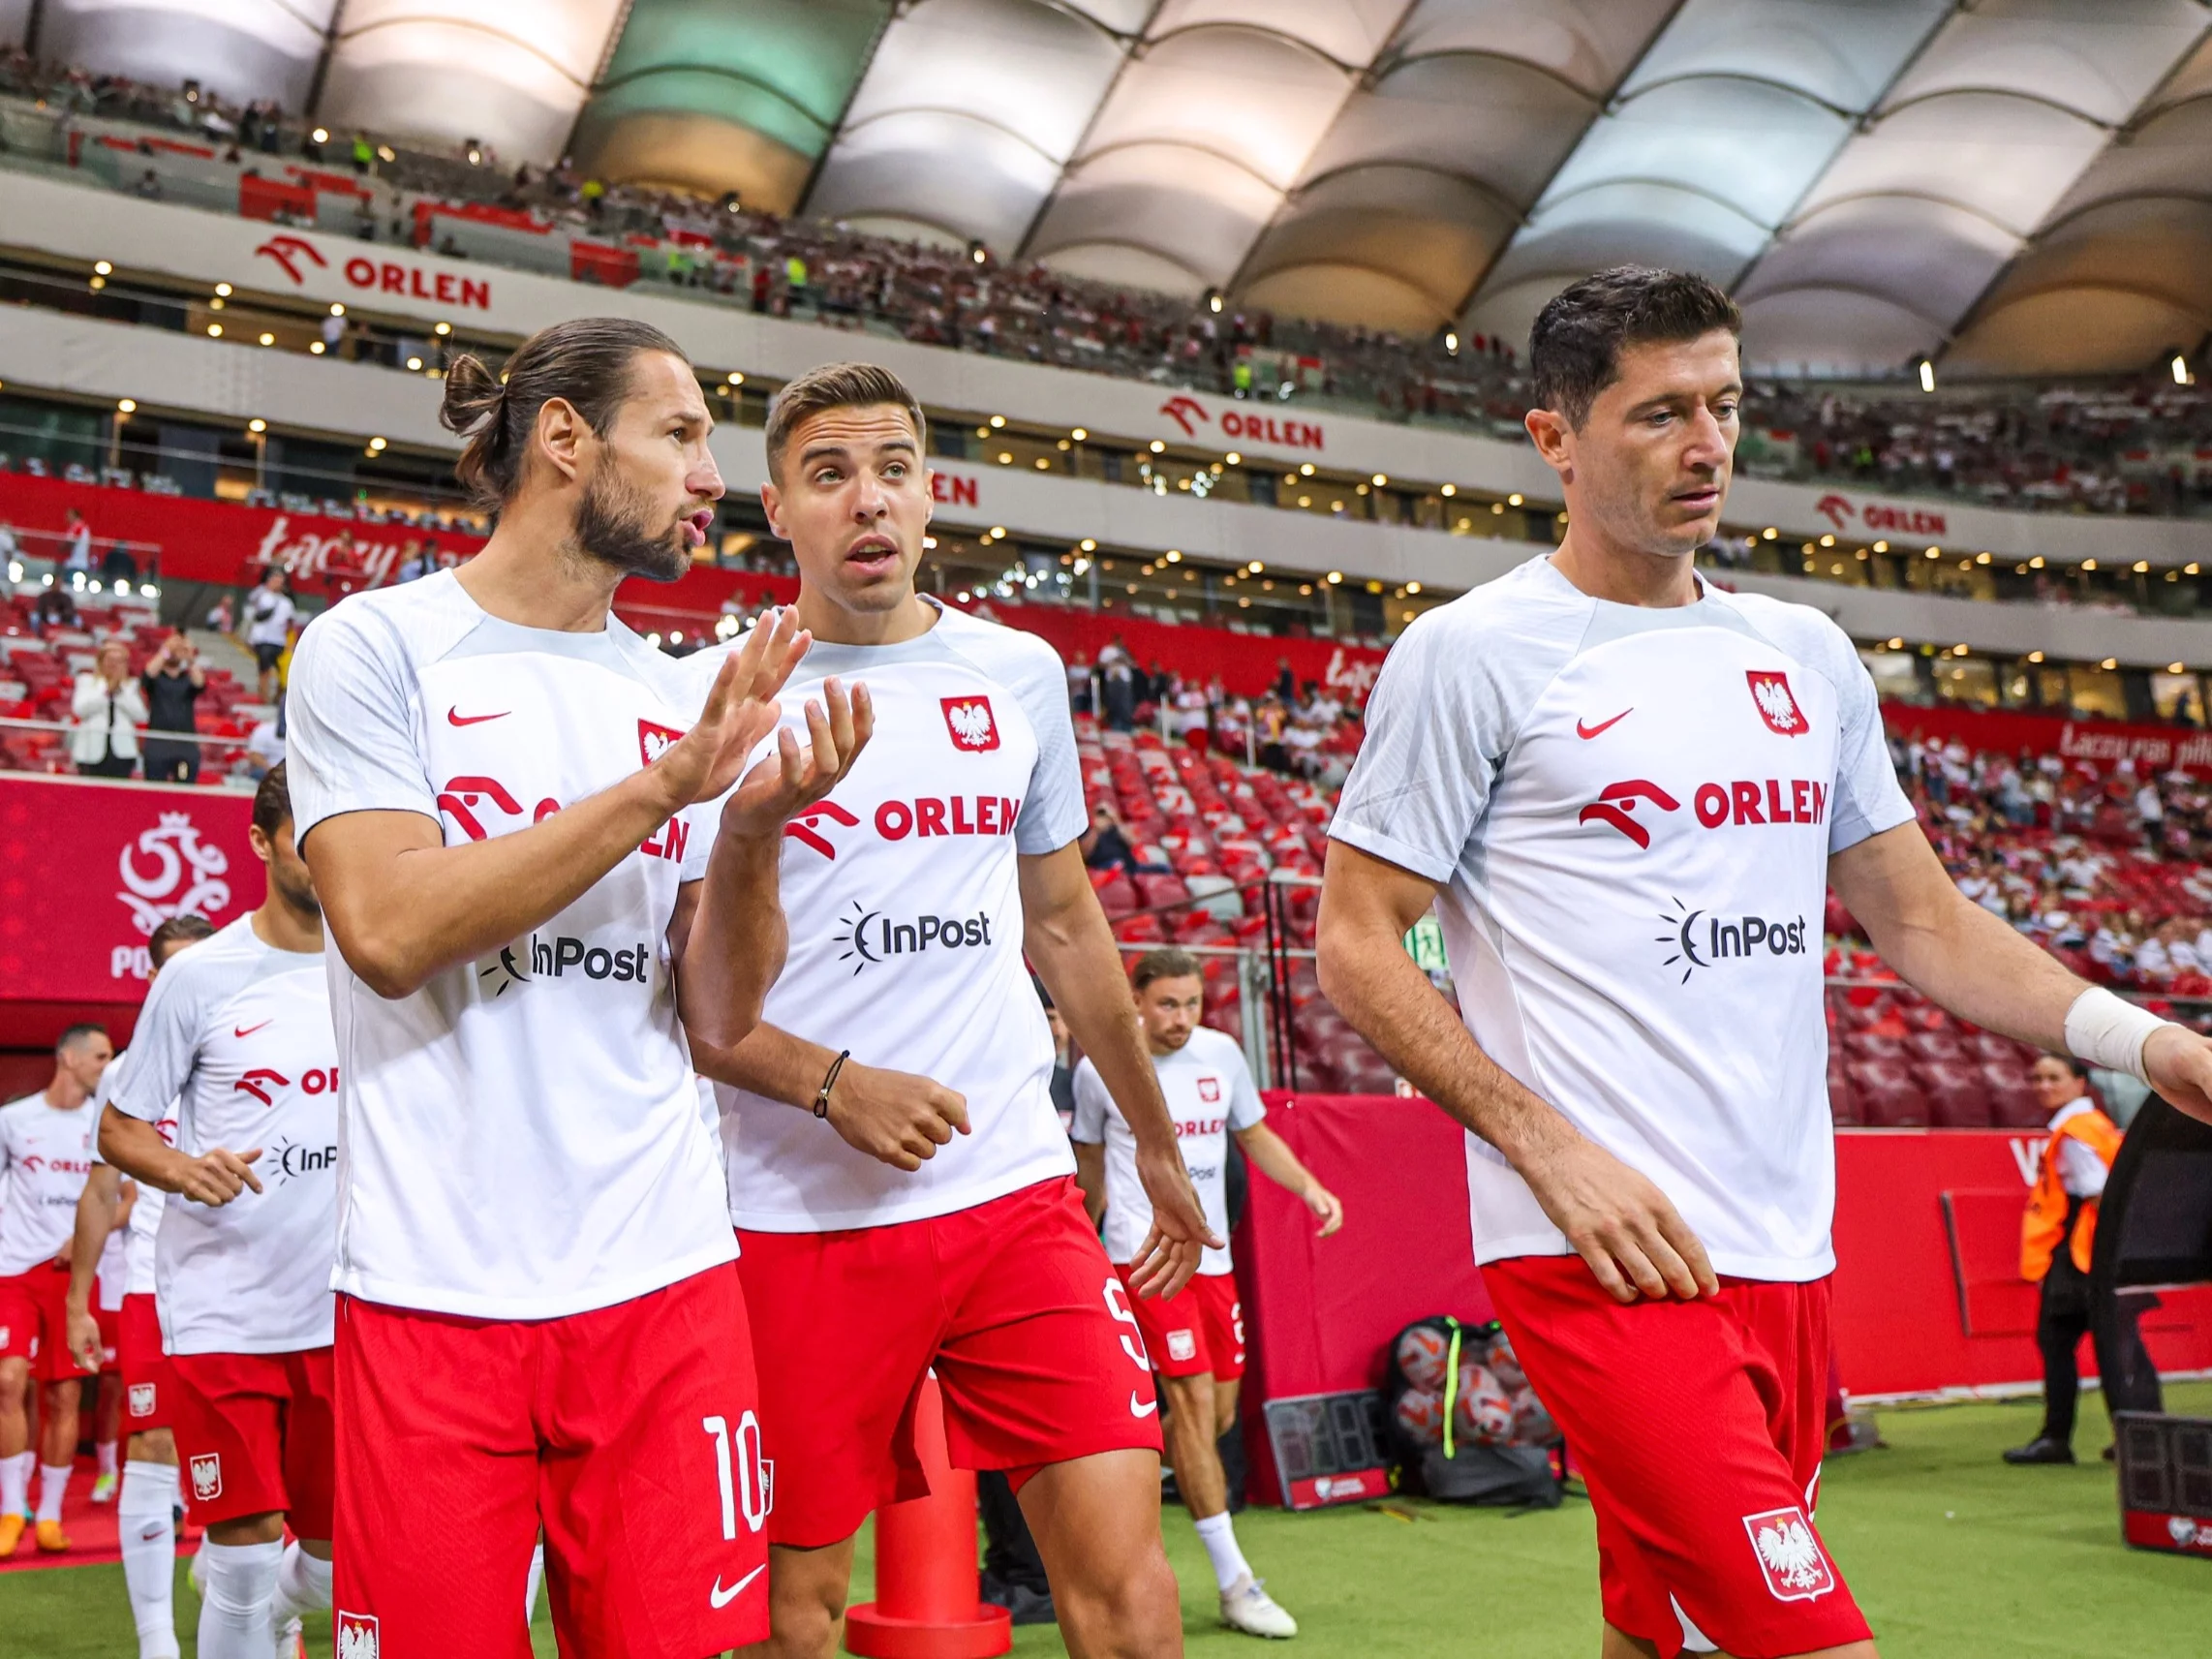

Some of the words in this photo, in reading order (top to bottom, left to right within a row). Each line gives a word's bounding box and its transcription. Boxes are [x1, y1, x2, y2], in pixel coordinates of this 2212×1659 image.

[344, 258, 490, 310] ORLEN
[1221, 411, 1322, 450] ORLEN
[1863, 505, 1946, 538] ORLEN
[875, 796, 1020, 841] ORLEN
[1694, 780, 1828, 829] ORLEN
[883, 911, 992, 954] InPost
[1710, 915, 1806, 958] InPost
[533, 934, 648, 983] InPost
[703, 1410, 765, 1540] 10
